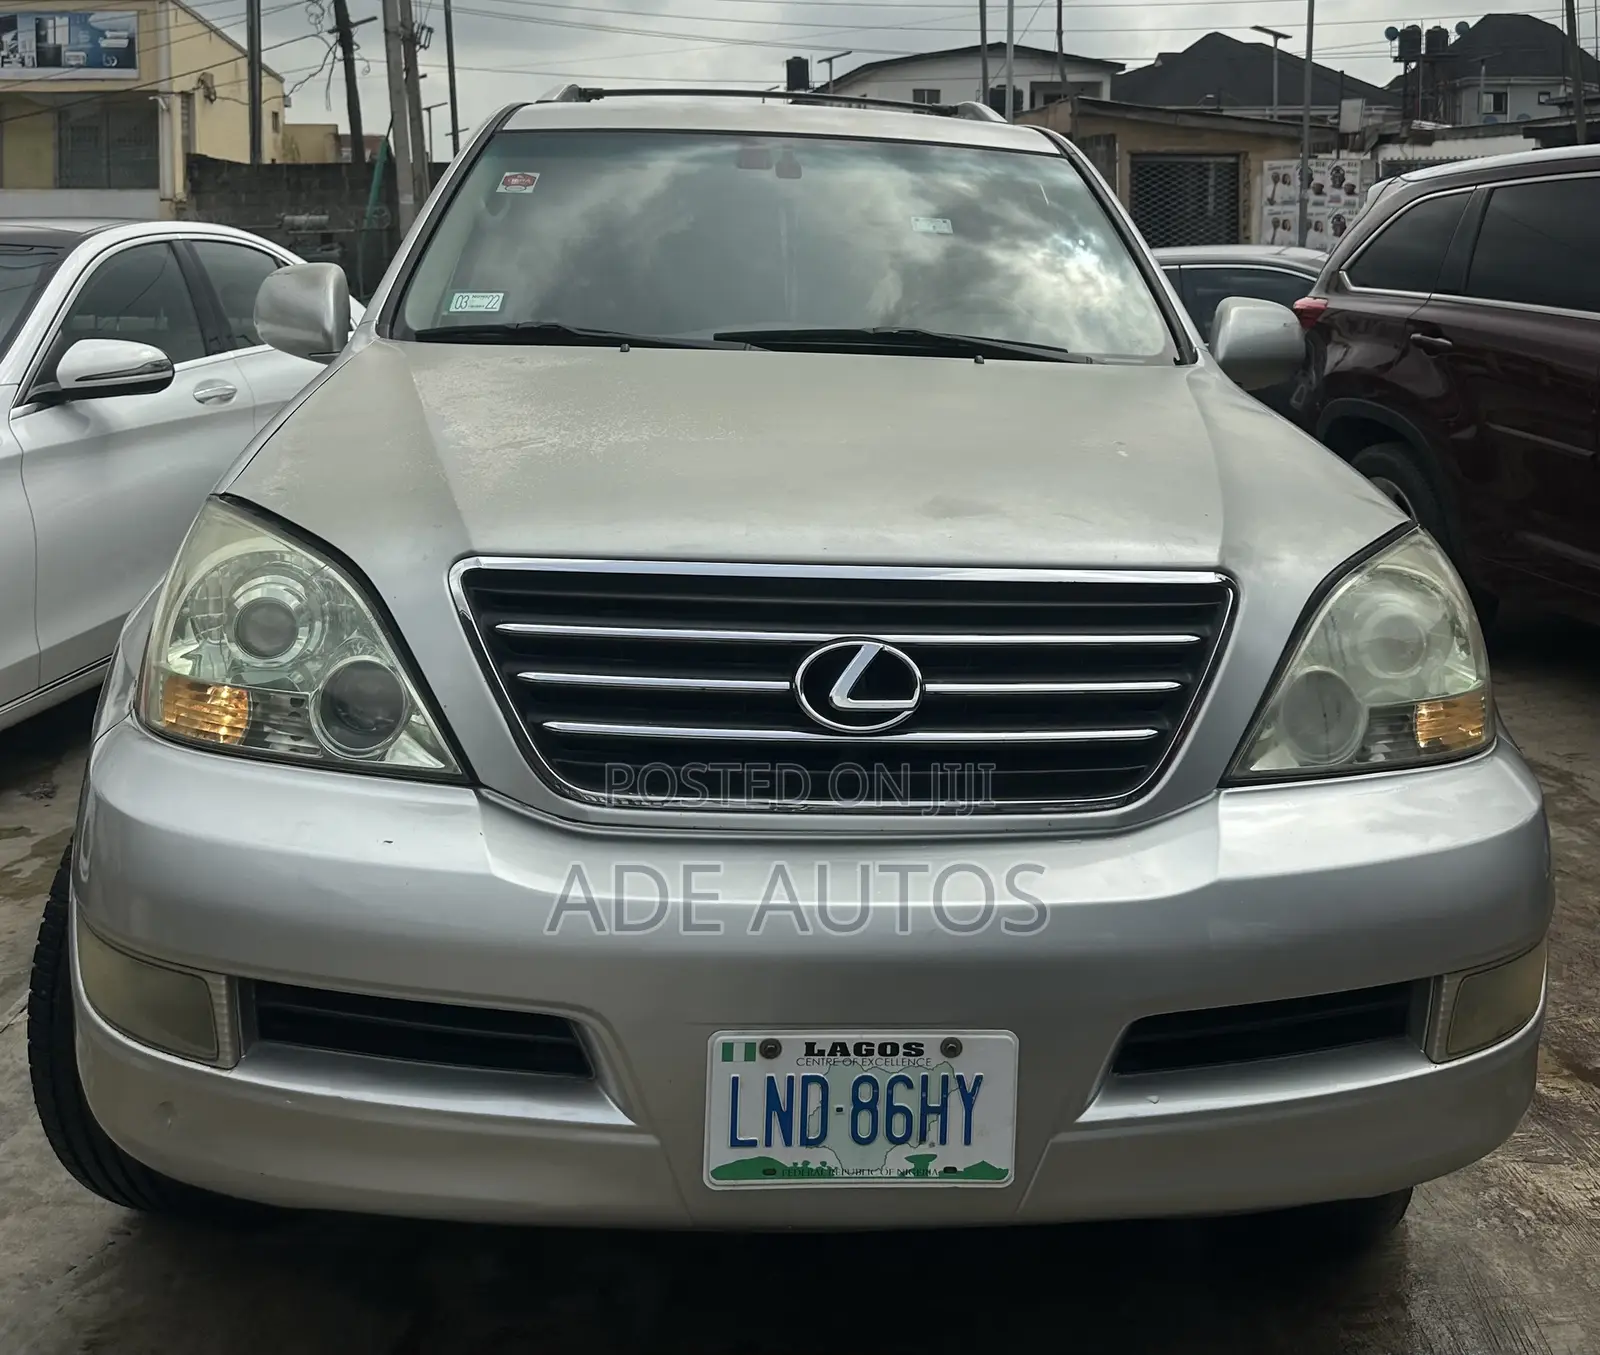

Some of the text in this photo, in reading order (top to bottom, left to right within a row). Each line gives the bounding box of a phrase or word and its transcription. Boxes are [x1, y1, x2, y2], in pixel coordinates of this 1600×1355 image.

[454, 294, 501, 310] 03 22
[803, 1041, 925, 1057] LAGOS
[796, 1057, 932, 1067] CENTRE OF EXCELLENCE
[729, 1073, 984, 1148] LND-86HY
[879, 1167, 893, 1177] OF
